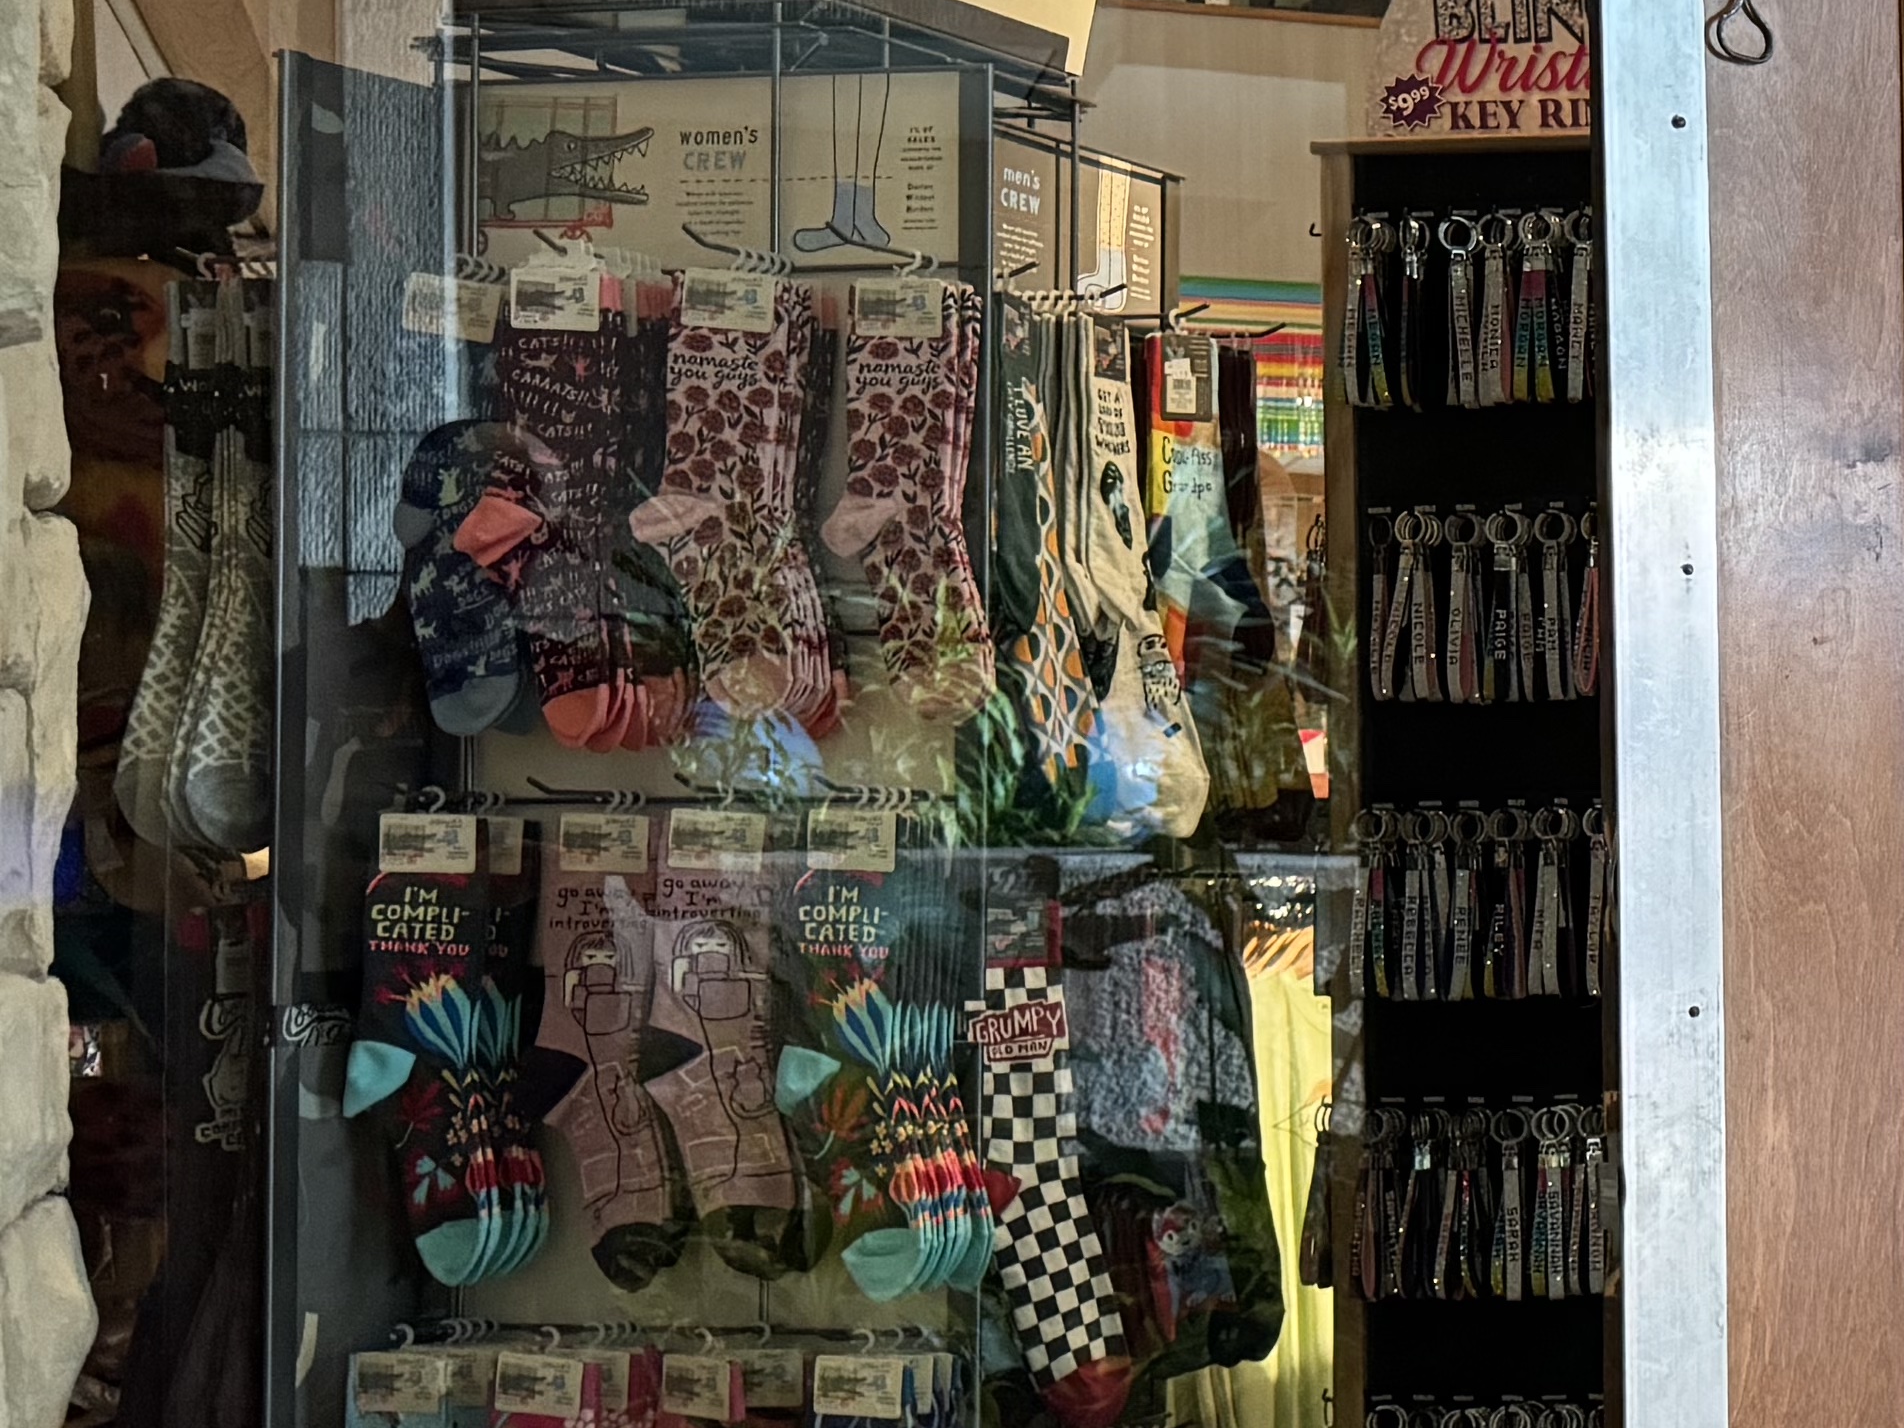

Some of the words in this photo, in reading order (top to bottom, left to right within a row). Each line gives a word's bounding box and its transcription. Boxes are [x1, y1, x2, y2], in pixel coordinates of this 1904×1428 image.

[1445, 99, 1526, 131] KEY
[679, 125, 759, 146] women's
[683, 149, 747, 172] CREW
[1002, 165, 1042, 191] men's
[1000, 187, 1041, 216] CREW
[1454, 294, 1474, 384] MICHELLE
[1489, 303, 1501, 370] MONICA
[1534, 296, 1550, 368] MORGAN
[672, 351, 760, 372] namaste
[857, 358, 941, 379] namaste
[669, 364, 709, 387] you
[713, 366, 760, 391] guys
[854, 375, 895, 395] you
[899, 374, 942, 396] guys
[1412, 602, 1426, 665] NICOLE
[1448, 608, 1462, 666] OLIVIA
[1494, 608, 1507, 661] PAIGE
[403, 885, 438, 906] I'M
[556, 887, 580, 908] go
[662, 877, 685, 898] go
[826, 885, 859, 906] I'M
[371, 903, 471, 924] COMPLI-
[797, 903, 890, 925] COMPLI-
[375, 921, 457, 942] CATED
[804, 922, 879, 943] CATED
[1402, 895, 1418, 976] REBECCA
[1454, 906, 1468, 966] RENEE
[1493, 903, 1505, 956] RILEY
[368, 940, 430, 957] THANK
[433, 941, 471, 957] YOU
[798, 942, 855, 959] THANK
[857, 942, 891, 959] YOU
[974, 1003, 1064, 1046] GRUMPY
[1016, 1039, 1051, 1055] MAN
[1506, 1206, 1520, 1263] SARAH
[1547, 1190, 1563, 1275] SAVANNAH
